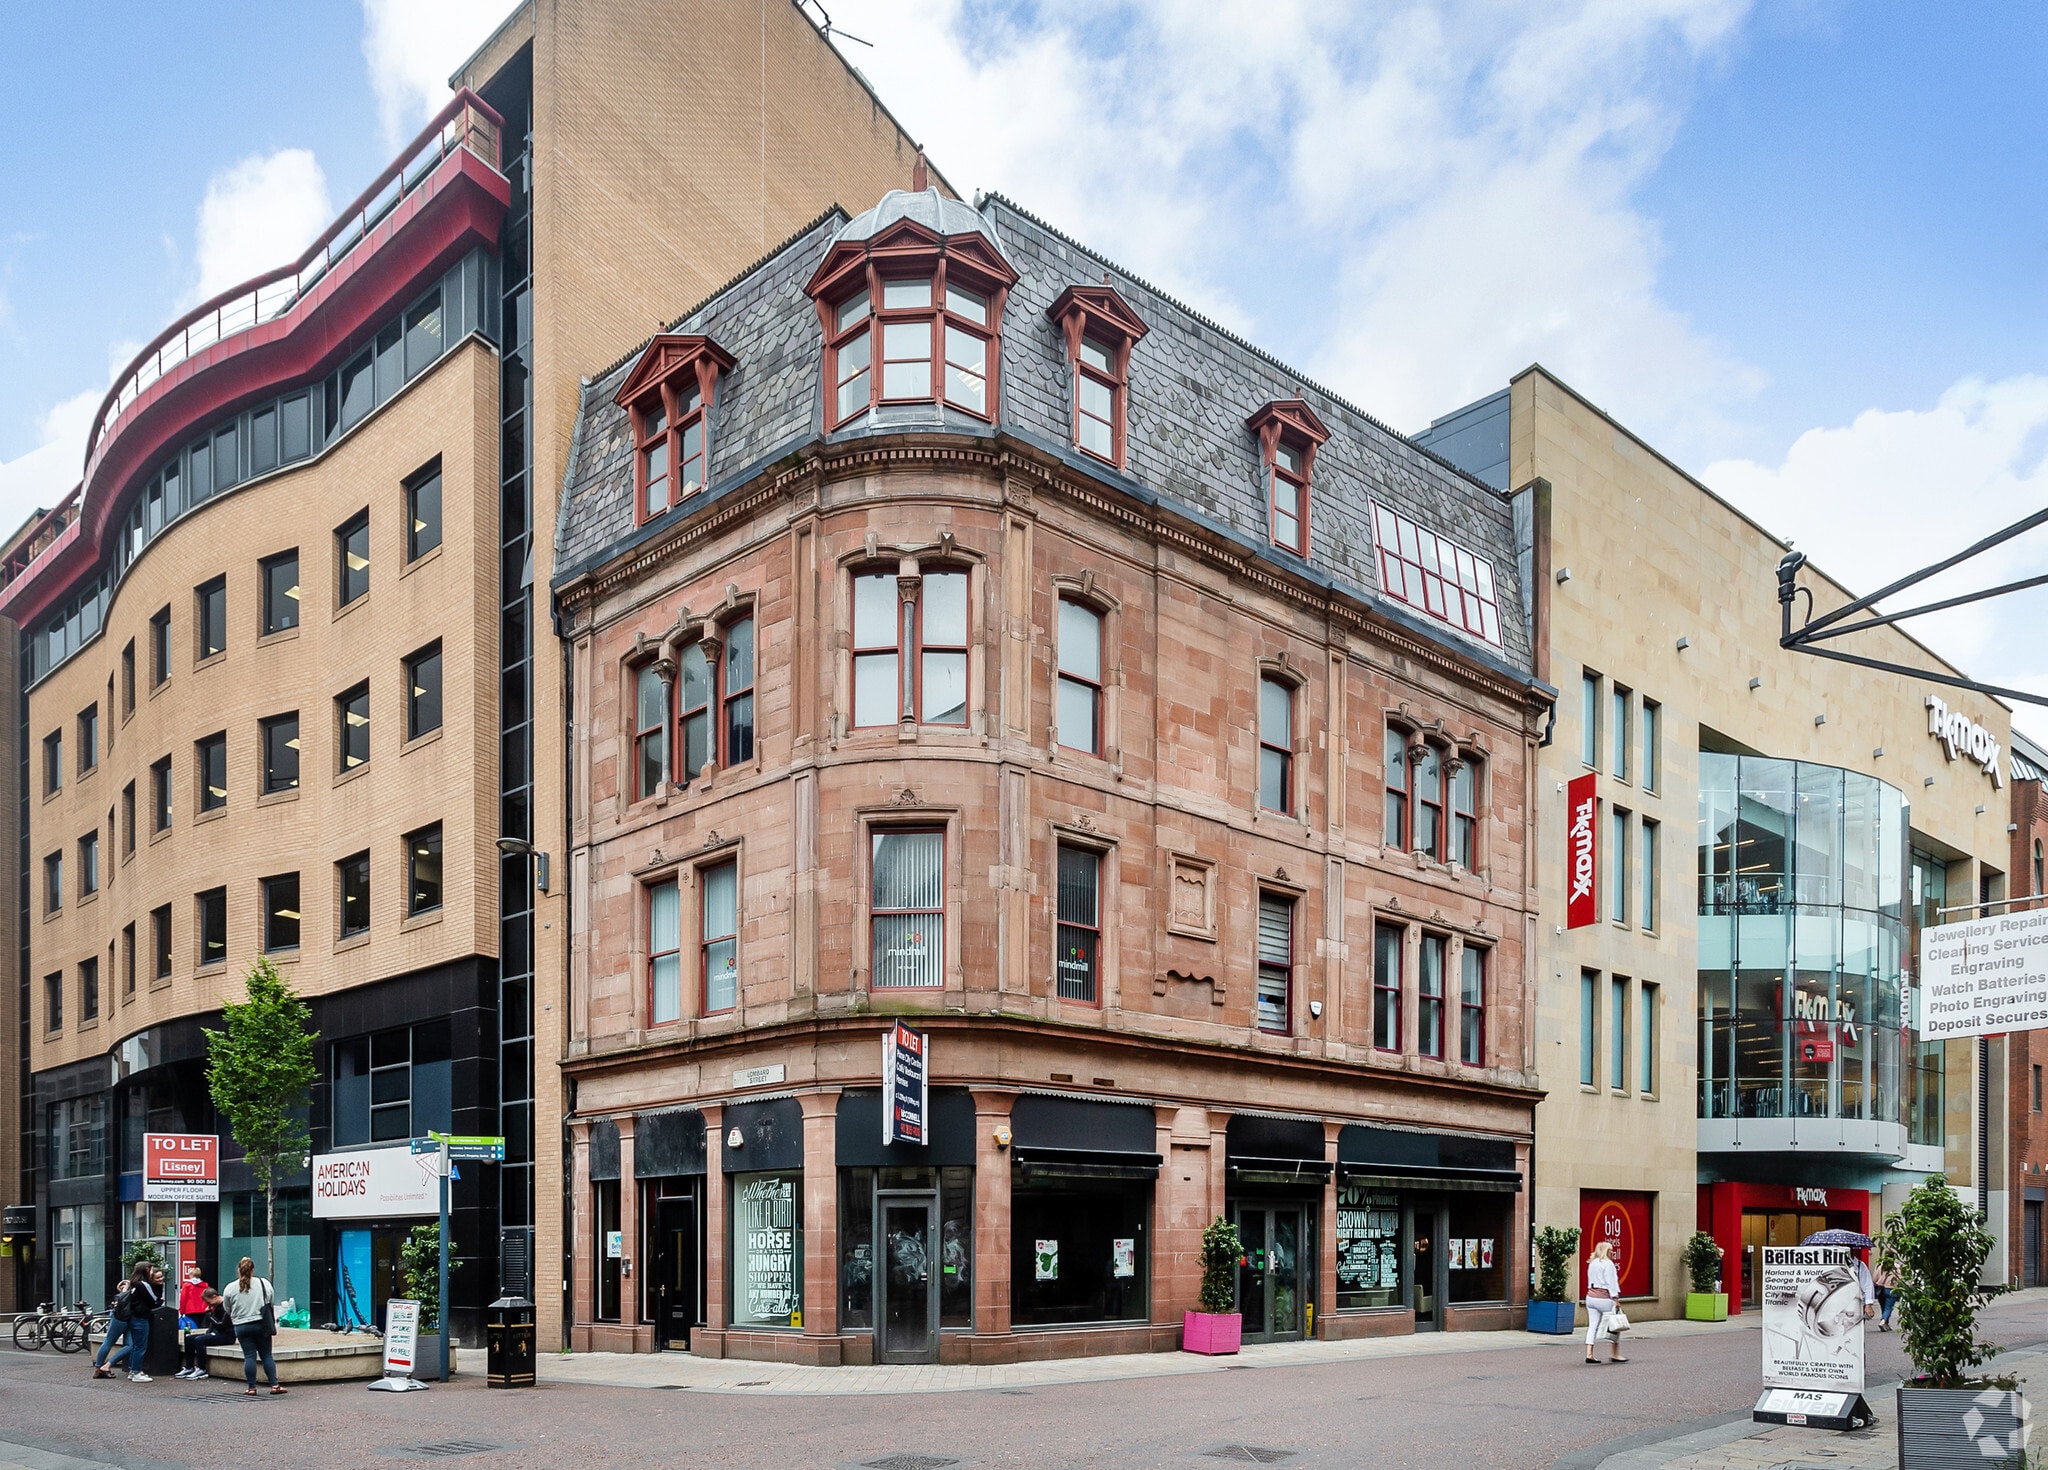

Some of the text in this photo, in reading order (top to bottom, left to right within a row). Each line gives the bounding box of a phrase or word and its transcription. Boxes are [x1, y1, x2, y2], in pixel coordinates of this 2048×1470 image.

[1930, 924, 1997, 943] Jewellery
[1928, 944, 1989, 961] Cleaning
[1951, 957, 2024, 976] Engraving
[1931, 973, 2046, 997] Watch Batteries
[1930, 991, 2047, 1014] Photo Engraving
[1928, 1009, 2048, 1032] Deposit Secures
[902, 1028, 910, 1047] TO
[910, 1034, 918, 1053] LET
[747, 1069, 770, 1079] LOMBARD
[749, 1076, 767, 1084] STREET
[152, 1138, 213, 1151] TO LET
[164, 1162, 201, 1173] Lisney
[318, 1161, 370, 1180] AMERICAN
[318, 1179, 366, 1197] HOLIDAYS
[748, 1178, 784, 1201] Whether
[1338, 1185, 1372, 1205] 70%
[748, 1200, 792, 1228] LIKE A BIRD
[1337, 1211, 1367, 1229] GROWN
[181, 1224, 191, 1235] TO
[1337, 1228, 1353, 1239] RIGHT
[1354, 1228, 1367, 1239] HERE
[1368, 1228, 1374, 1239] IN
[1605, 1215, 1621, 1237] big
[748, 1232, 792, 1249] HORSE
[748, 1254, 792, 1271] HUNGRY
[1765, 1249, 1847, 1264] Belfast Rin
[748, 1272, 792, 1282] SHOPPER
[1793, 1392, 1823, 1400] MAS
[1769, 1399, 1838, 1414] SILVER
